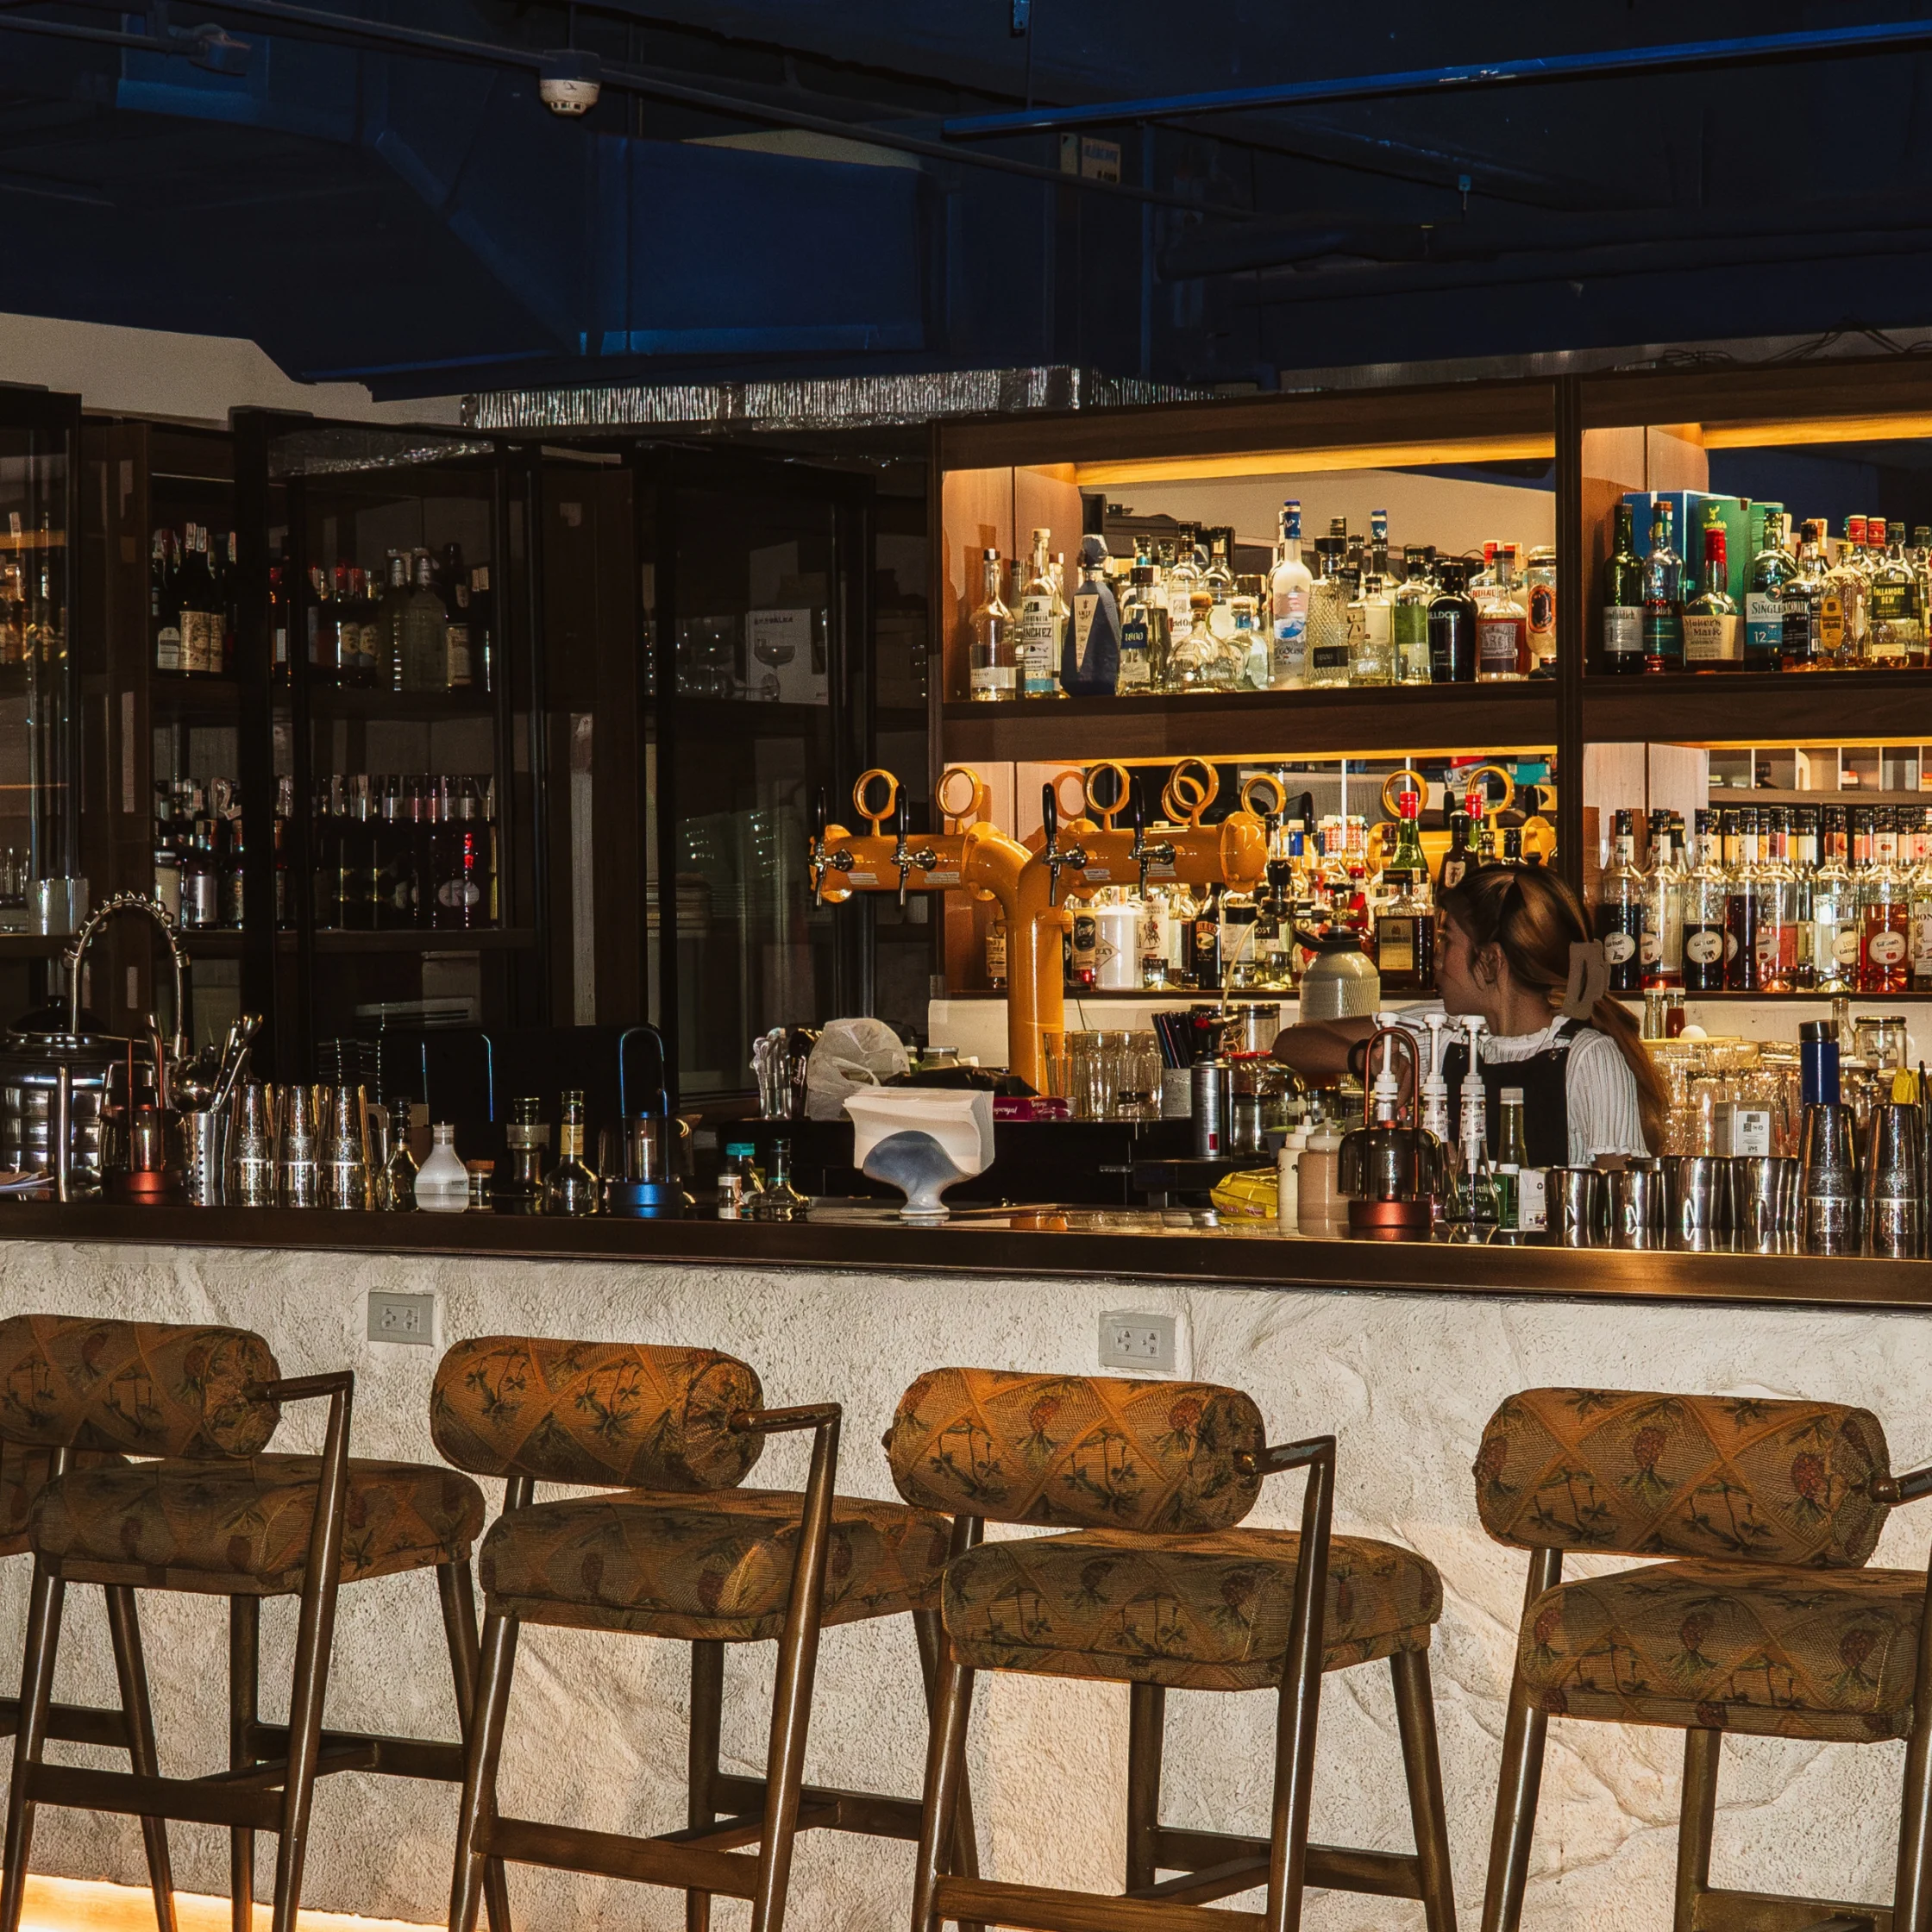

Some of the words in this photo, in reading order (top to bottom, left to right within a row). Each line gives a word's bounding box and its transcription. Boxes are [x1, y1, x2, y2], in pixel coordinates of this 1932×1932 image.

[1751, 601, 1784, 615] SINGLE
[1125, 631, 1144, 642] 1800
[1753, 630, 1767, 644] 12
